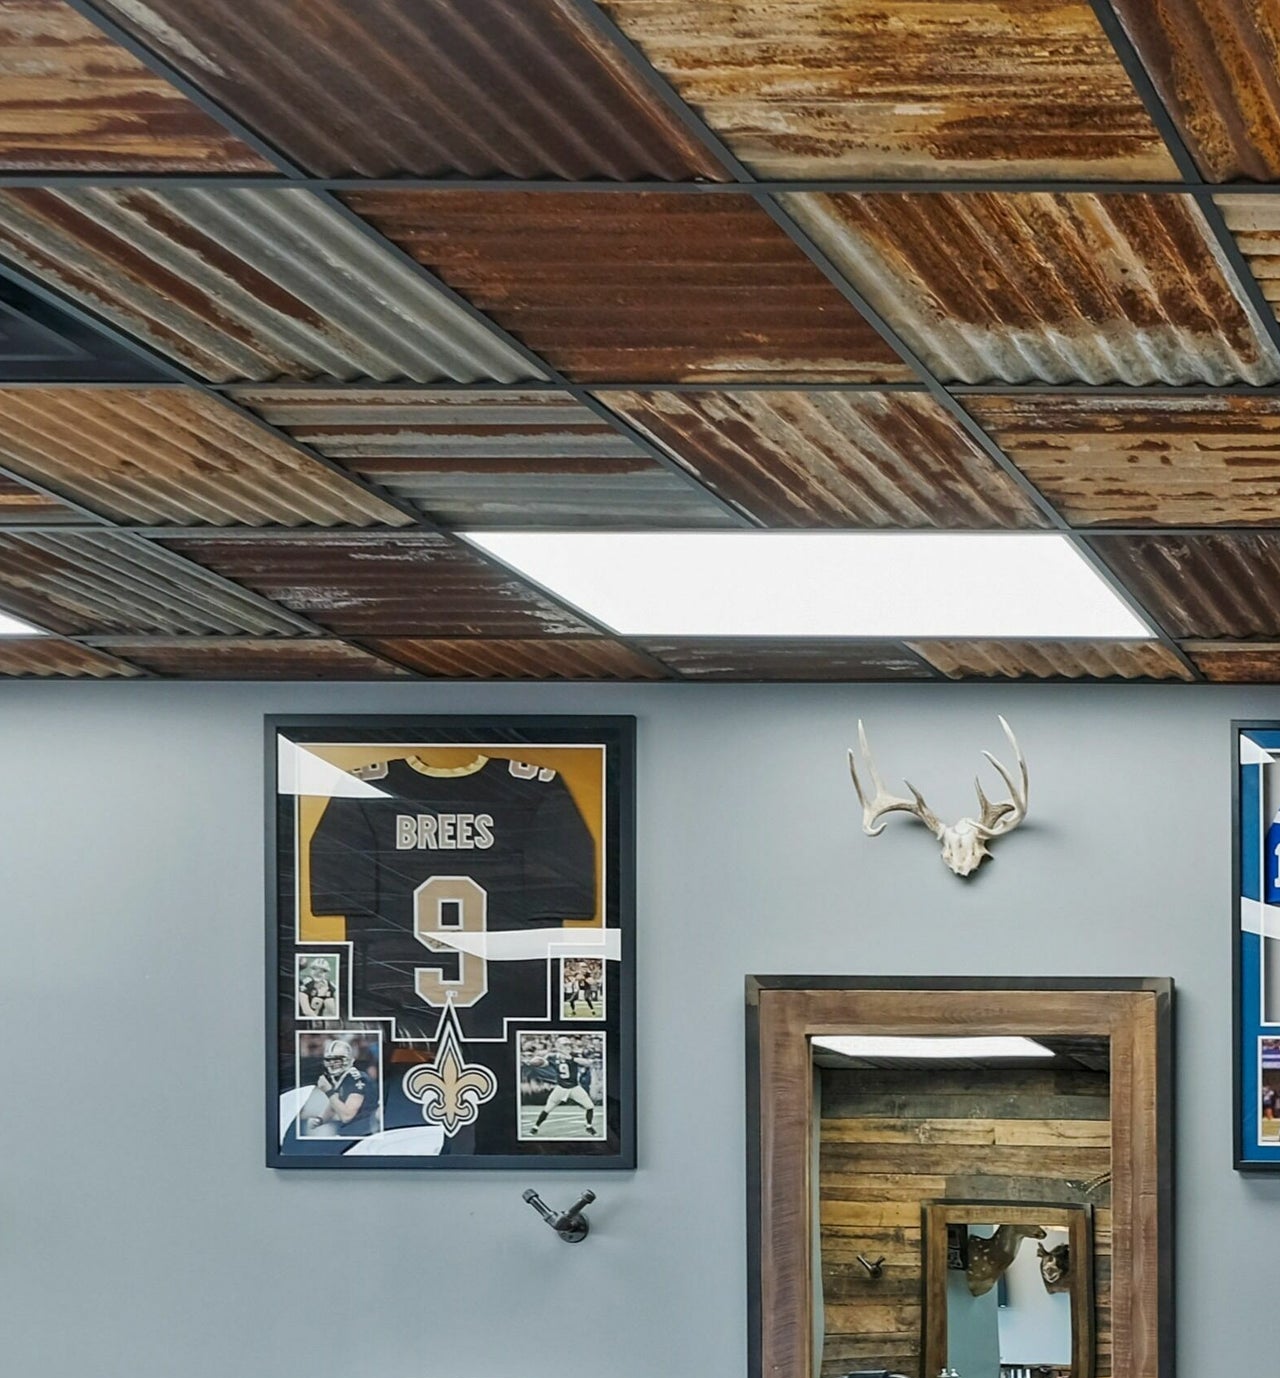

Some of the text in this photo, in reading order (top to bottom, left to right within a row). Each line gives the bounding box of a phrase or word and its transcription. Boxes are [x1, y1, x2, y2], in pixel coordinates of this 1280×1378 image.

[396, 814, 494, 850] BREES
[413, 875, 488, 1008] 9
[559, 1063, 570, 1079] 9
